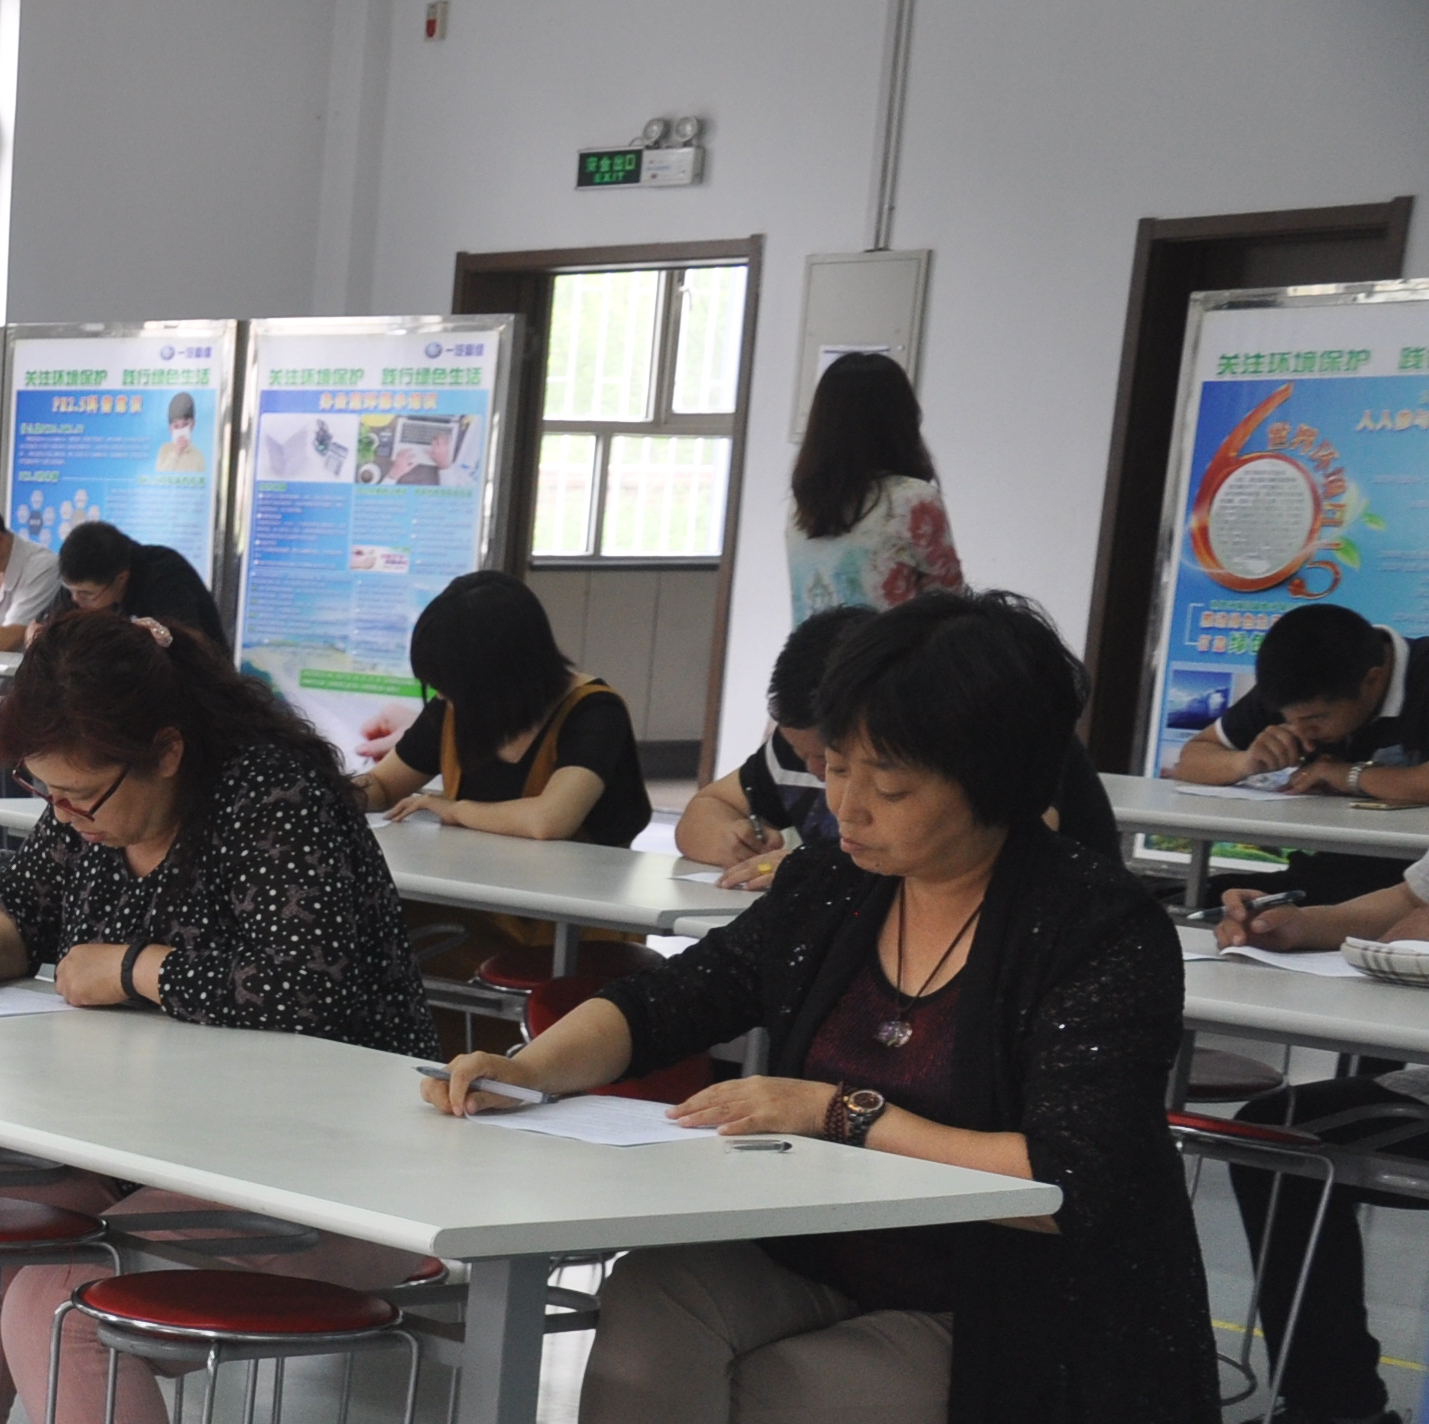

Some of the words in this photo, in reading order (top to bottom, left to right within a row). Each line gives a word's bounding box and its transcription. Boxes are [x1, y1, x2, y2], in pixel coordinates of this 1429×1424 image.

[585, 154, 636, 172] 安全出口
[593, 172, 626, 183] EXIT
[1216, 348, 1371, 376] 关注环境保护
[24, 369, 108, 386] 关注环境保护
[122, 368, 211, 386] 践行绿色生活
[269, 368, 365, 386] 关注环境保护
[381, 367, 483, 386] 践行绿色生活
[1267, 420, 1347, 527] 世界环境日
